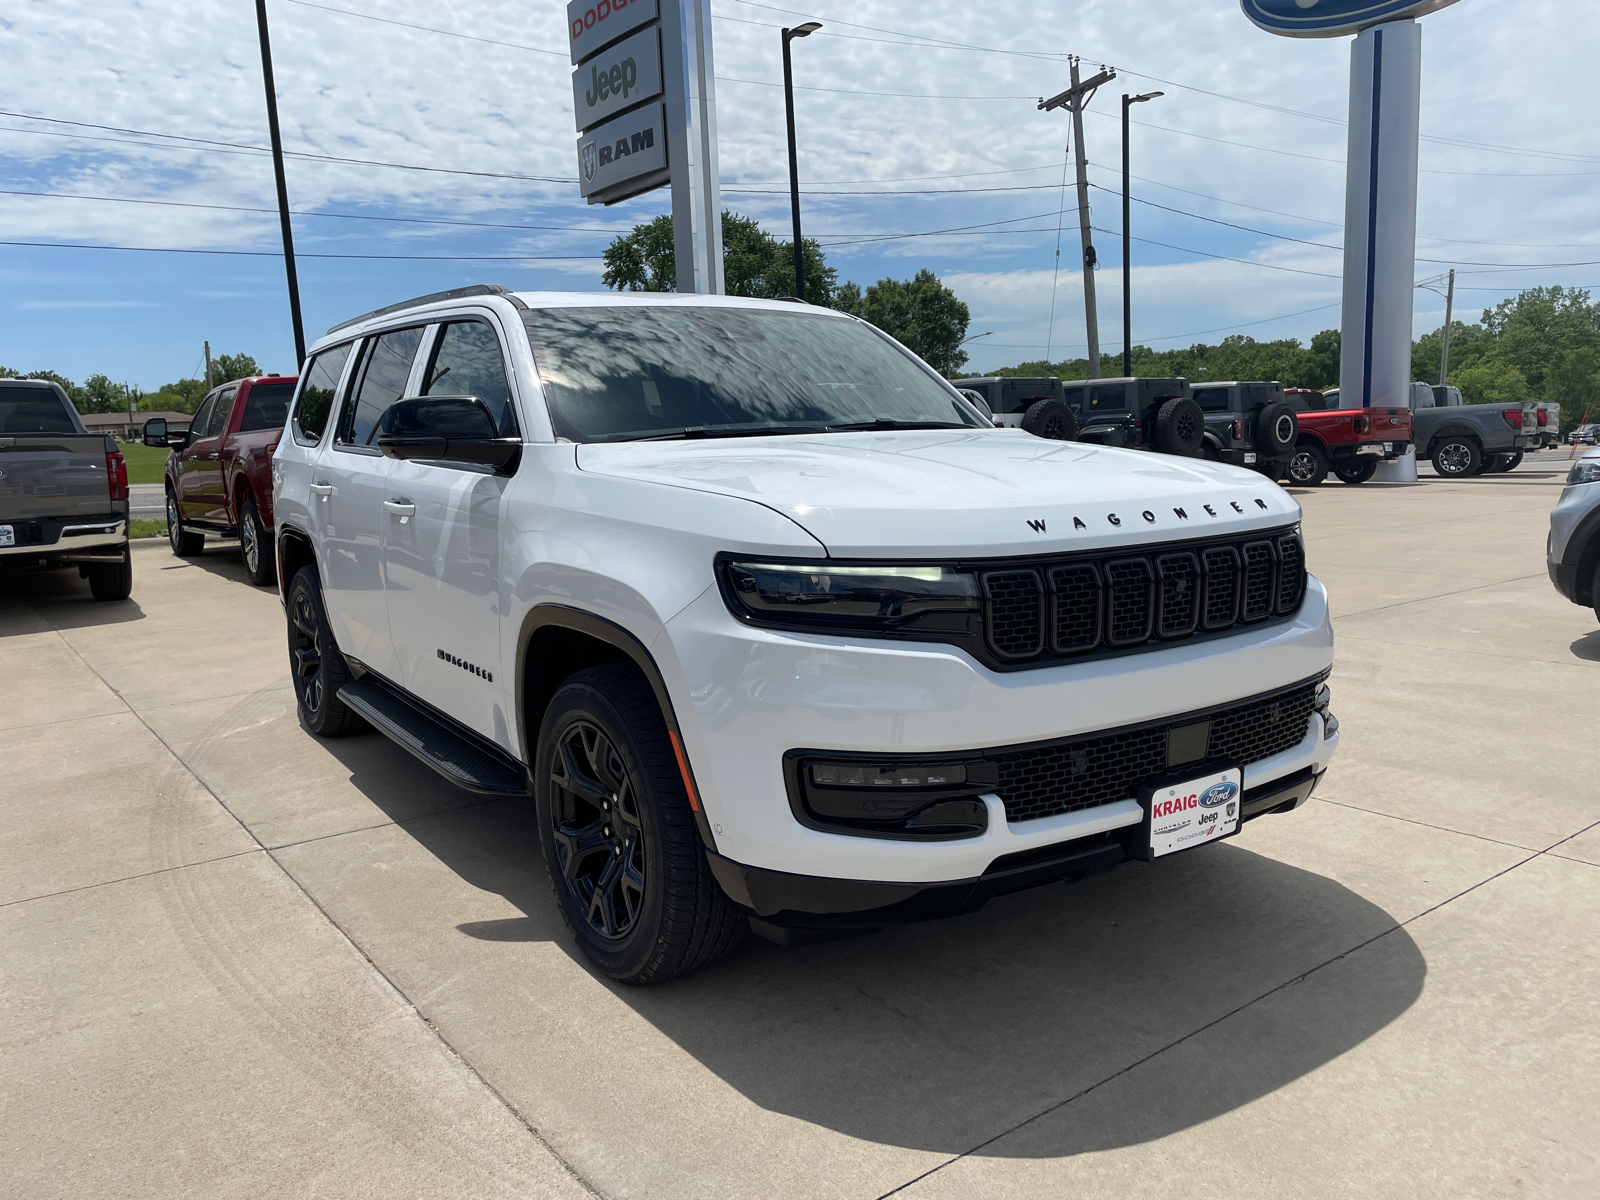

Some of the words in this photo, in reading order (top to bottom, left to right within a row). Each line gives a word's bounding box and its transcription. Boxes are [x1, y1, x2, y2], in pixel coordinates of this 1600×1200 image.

[572, 0, 638, 40] DODG
[585, 57, 637, 107] Jeep
[599, 127, 654, 166] RAM
[1026, 498, 1268, 534] WAGONEER
[445, 652, 493, 682] WAGONEER
[1153, 794, 1197, 819] KRAIG
[1206, 786, 1230, 804] Ford
[1198, 812, 1218, 825] Jeep
[1153, 819, 1191, 832] CHRYSLER
[1176, 828, 1209, 843] DODGE
